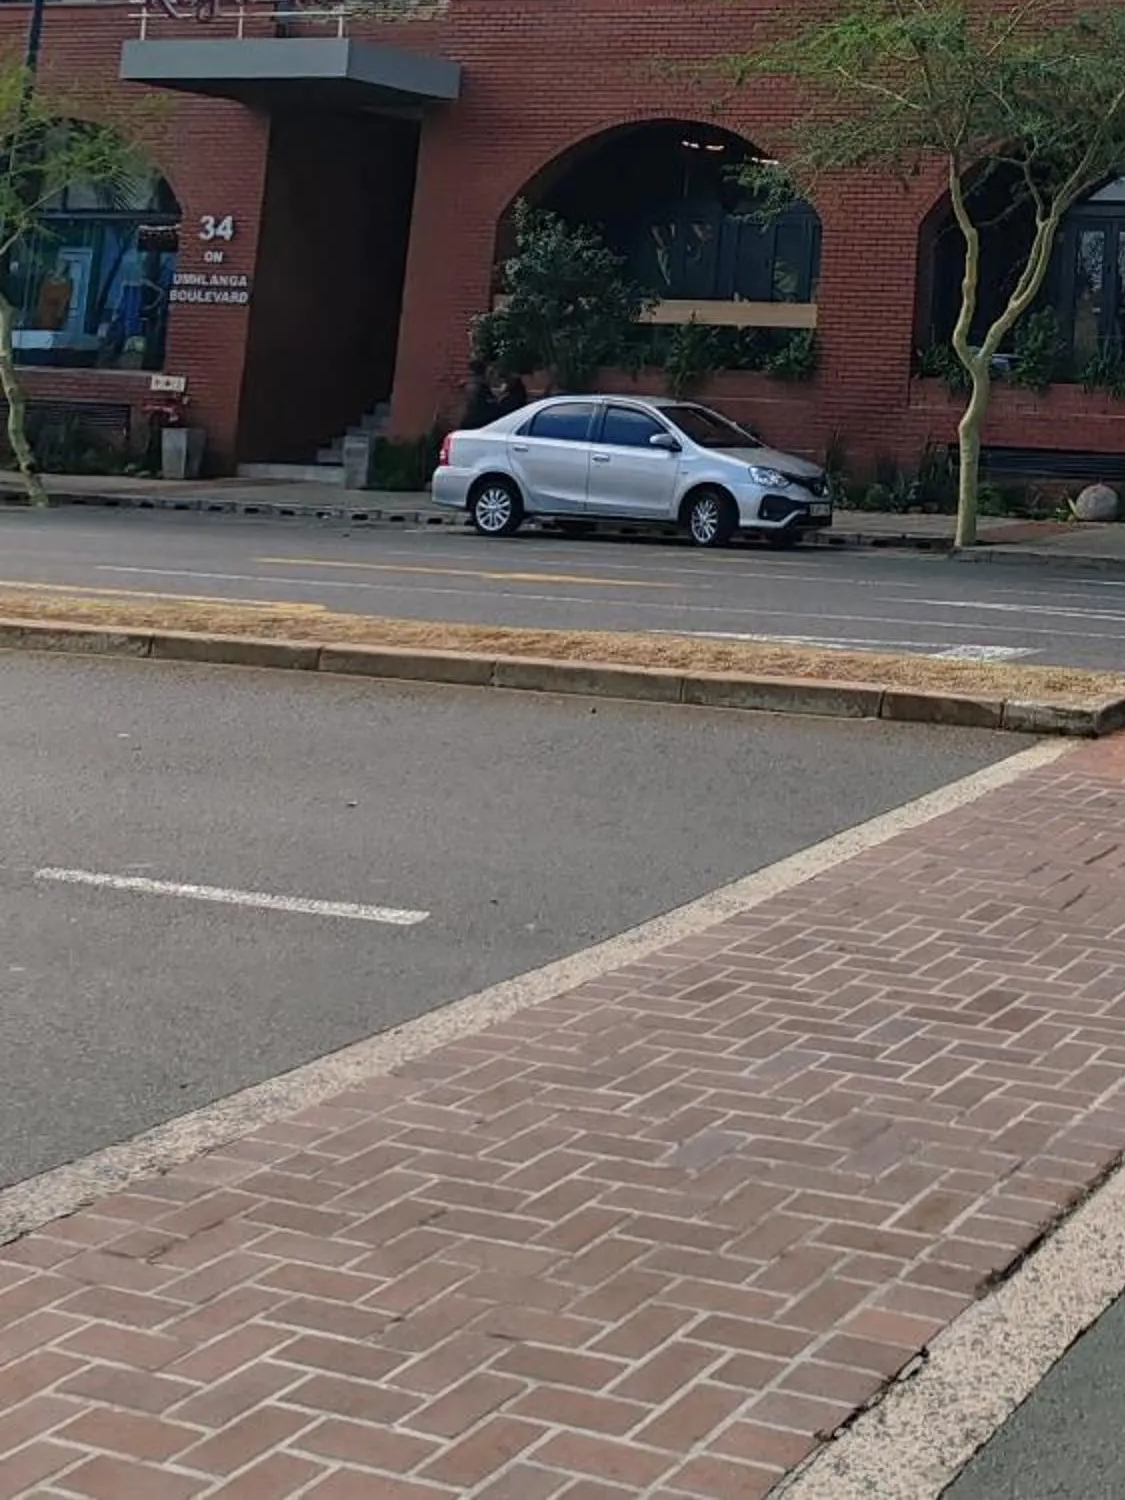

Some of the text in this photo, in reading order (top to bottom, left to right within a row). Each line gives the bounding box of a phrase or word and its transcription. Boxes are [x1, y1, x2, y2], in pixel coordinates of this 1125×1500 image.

[200, 216, 234, 241] 34
[204, 252, 223, 263] ON
[169, 289, 249, 304] BOULEVARD
